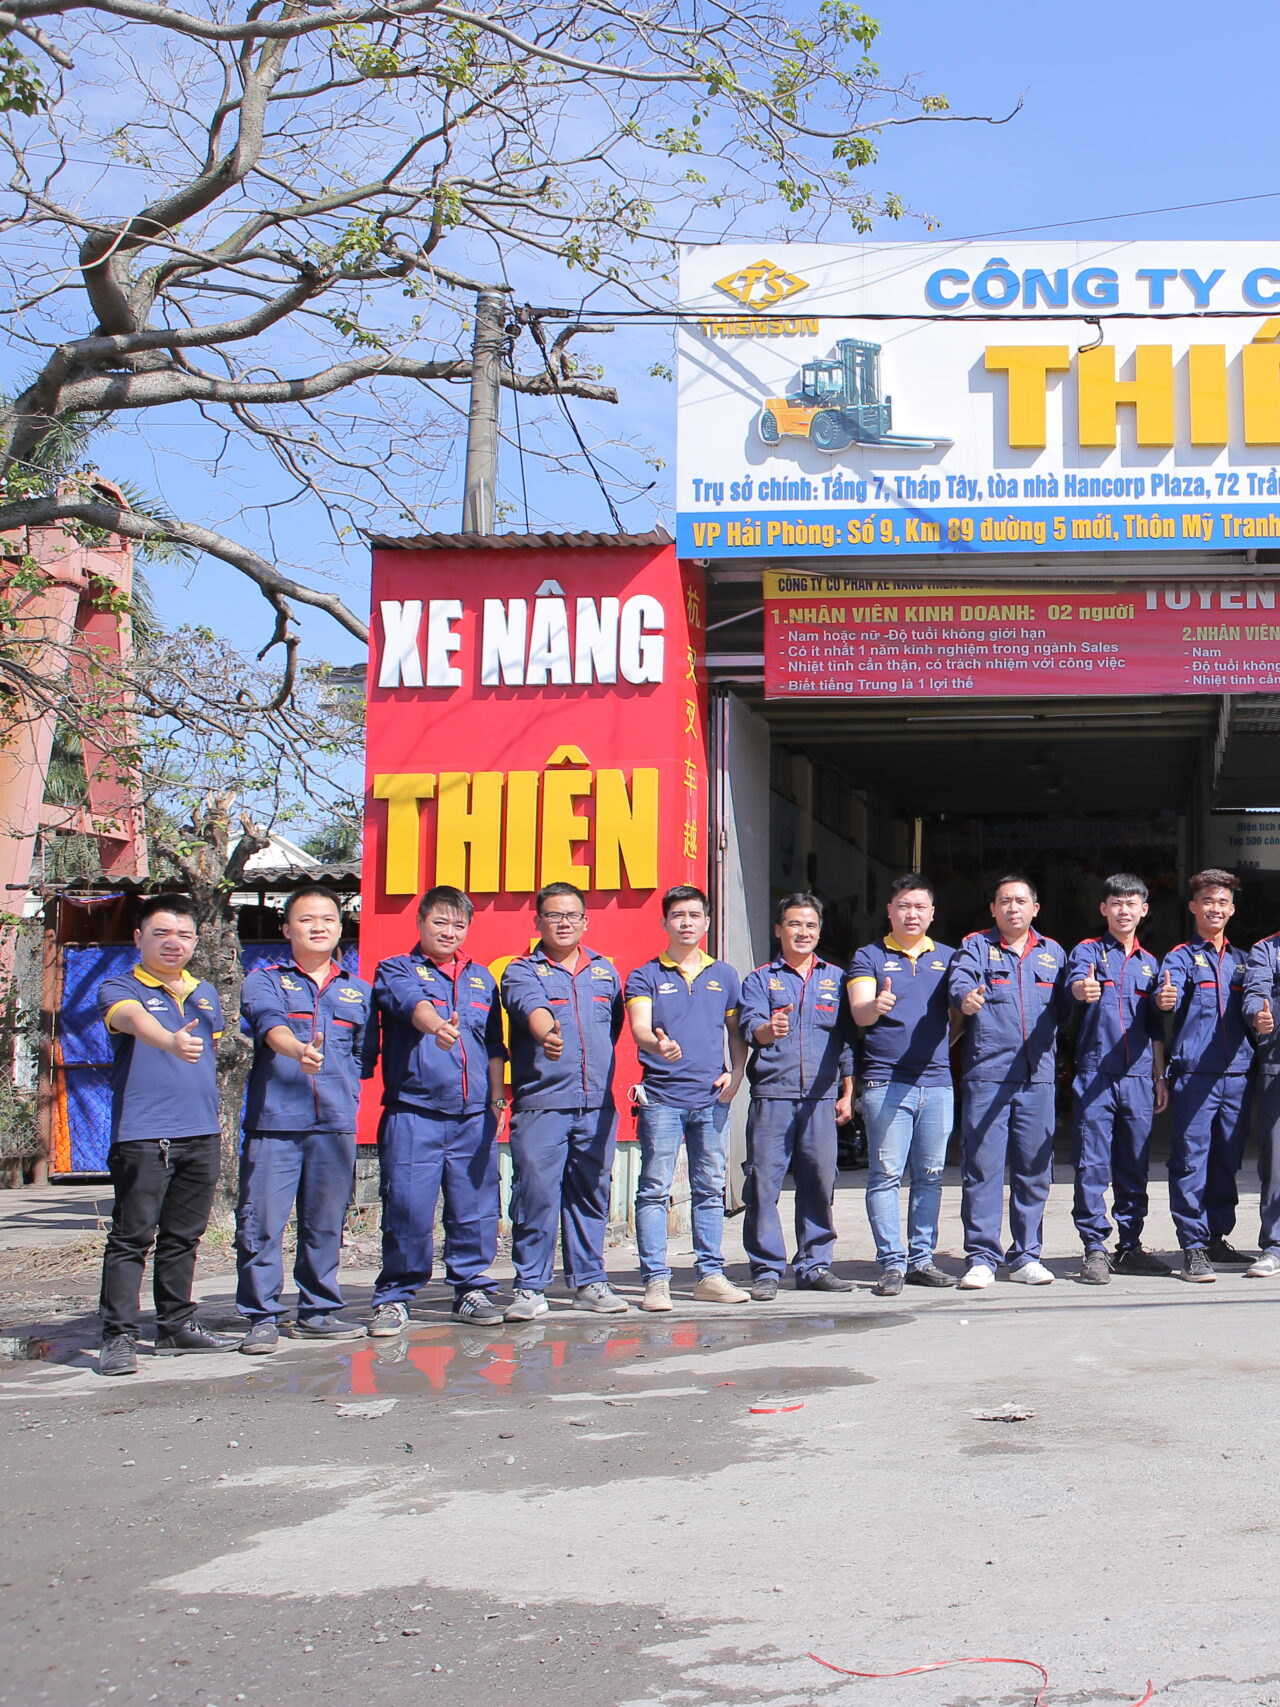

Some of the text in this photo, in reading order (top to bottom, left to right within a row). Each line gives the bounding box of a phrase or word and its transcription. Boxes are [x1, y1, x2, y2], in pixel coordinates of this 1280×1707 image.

[925, 257, 1120, 309] CÔNG
[1134, 268, 1227, 307] TY
[692, 478, 724, 506] Trụ
[730, 474, 753, 502] sở
[757, 476, 819, 502] chính:
[872, 476, 890, 503] 7,
[894, 475, 941, 502] Tháp
[946, 473, 983, 501] Tây,
[987, 473, 1018, 499] tòa
[1023, 472, 1059, 499] nhà
[1064, 473, 1145, 500] Hancorp
[1151, 472, 1211, 500] Plaza,
[1215, 472, 1240, 497] 72
[692, 521, 721, 548] VP
[726, 517, 762, 548] Hải
[766, 519, 842, 548] Phòng:
[847, 513, 877, 544] Số
[879, 518, 901, 547] 9,
[905, 517, 941, 543] Km
[947, 517, 975, 543] 89
[980, 514, 1047, 545] đường
[1053, 515, 1067, 542] 5
[1071, 511, 1119, 542] mới,
[1123, 511, 1175, 539] Thôn
[1182, 511, 1214, 542] Mỹ
[778, 576, 808, 592] CÔNG
[810, 576, 823, 591] TY
[771, 603, 1135, 625] 1.NHÂN VIÊN KINH DOANH: 02 người
[378, 578, 665, 688] XE NÂNG
[788, 630, 819, 642] Nam
[823, 629, 856, 644] hoặc
[860, 629, 880, 641] nữ
[911, 626, 938, 640] tuổi
[942, 629, 985, 642] không
[989, 628, 1017, 642] giới
[1020, 627, 1046, 641] hạn
[1182, 623, 1241, 642] 2.NHÂN
[1244, 623, 1280, 641] VIÊN
[788, 641, 1119, 657] Có ít nhất 1 năm kinh nghiệm trong ngành Sales
[1192, 647, 1222, 657] Nam
[788, 656, 1126, 674] Nhiệt tình cẩn thận, có trách nhiệm với công việc
[1192, 660, 1211, 673] Độ
[1214, 658, 1239, 671] tuổi
[788, 675, 974, 694] Biết tiếng Trung là 1 lợi thế
[1193, 674, 1227, 687] Nhiệt
[1230, 674, 1255, 685] tình
[373, 744, 660, 896] THIÊN
[1246, 836, 1262, 846] 500
